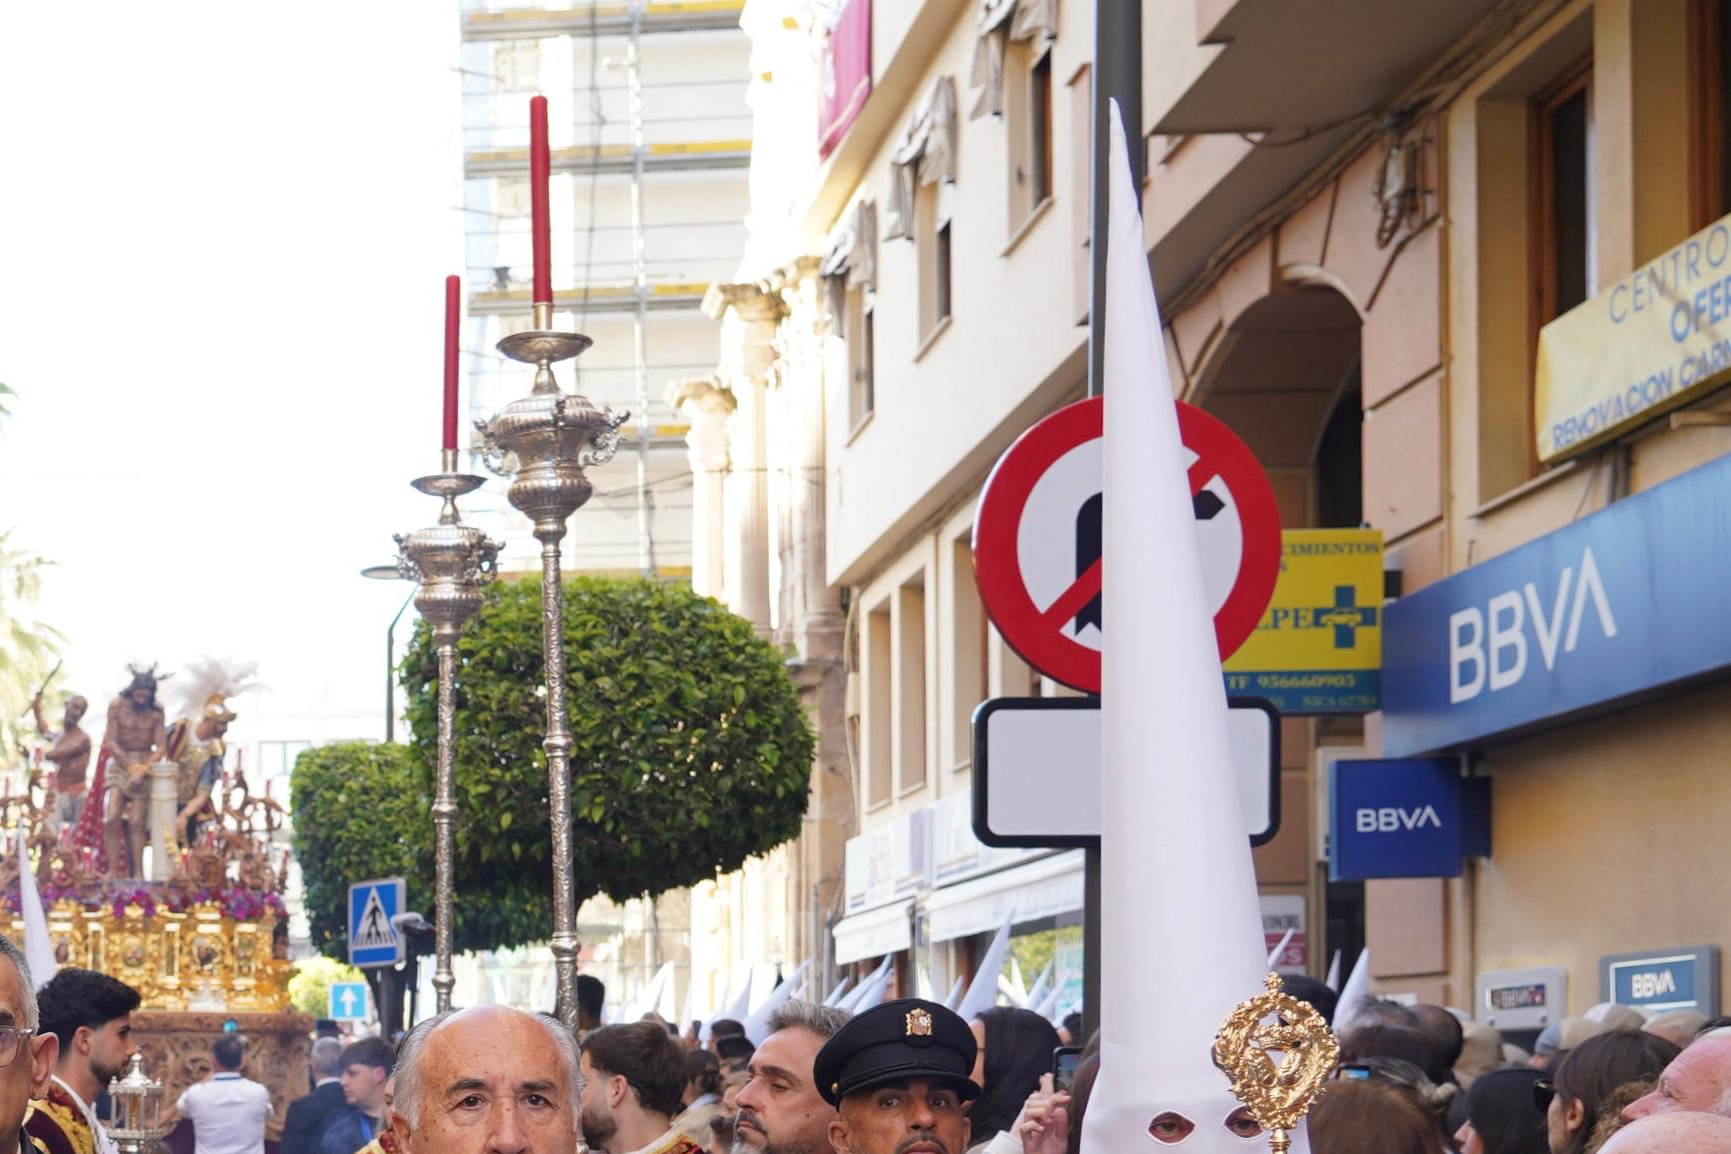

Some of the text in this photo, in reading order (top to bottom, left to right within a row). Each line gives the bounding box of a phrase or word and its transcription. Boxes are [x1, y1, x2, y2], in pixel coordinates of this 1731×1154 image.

[1608, 224, 1729, 324] CENTRO
[1552, 366, 1673, 450] RENOVACION
[1450, 546, 1618, 704] BBVA
[1356, 805, 1442, 832] BBVA
[1631, 969, 1676, 998] BBVA
